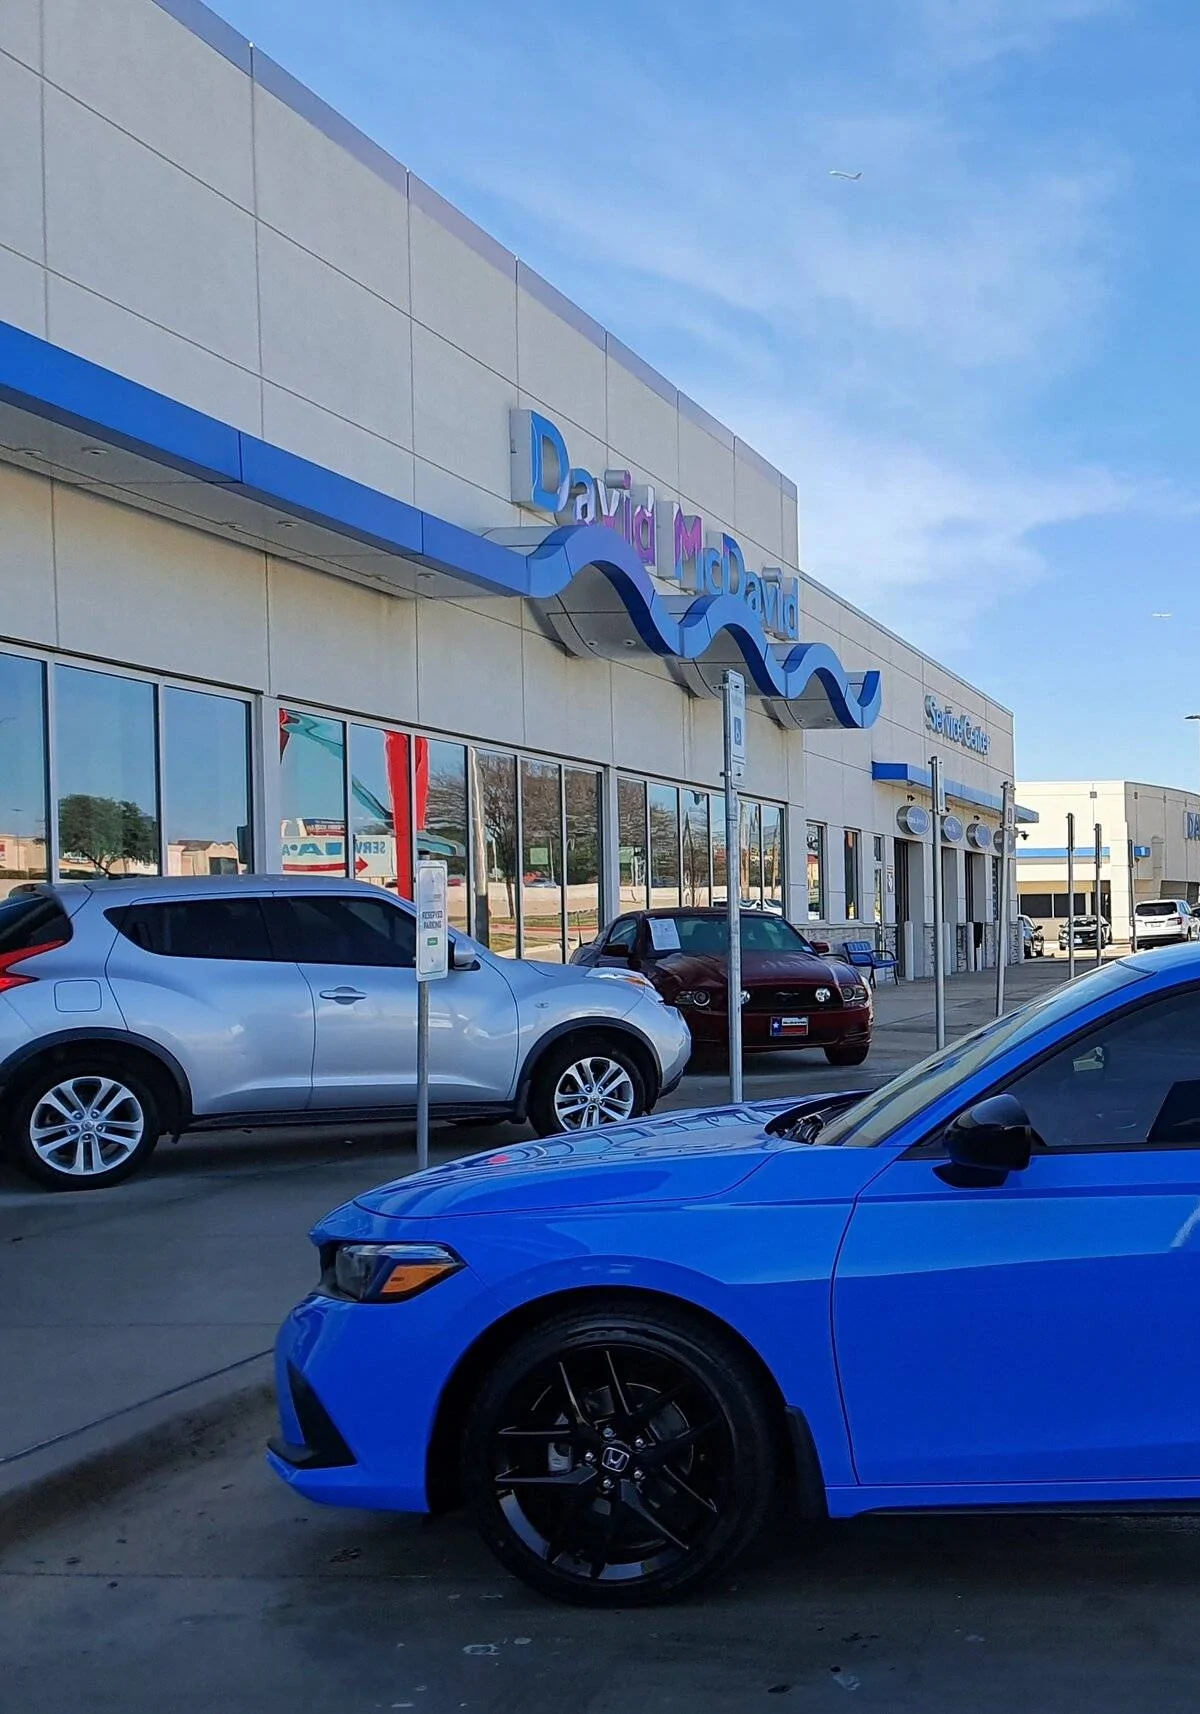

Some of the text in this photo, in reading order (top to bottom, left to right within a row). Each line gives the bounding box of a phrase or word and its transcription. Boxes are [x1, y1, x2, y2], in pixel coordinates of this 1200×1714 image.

[511, 408, 799, 640] David McDavid
[925, 695, 991, 756] Service Center
[423, 920, 442, 929] PARKING
